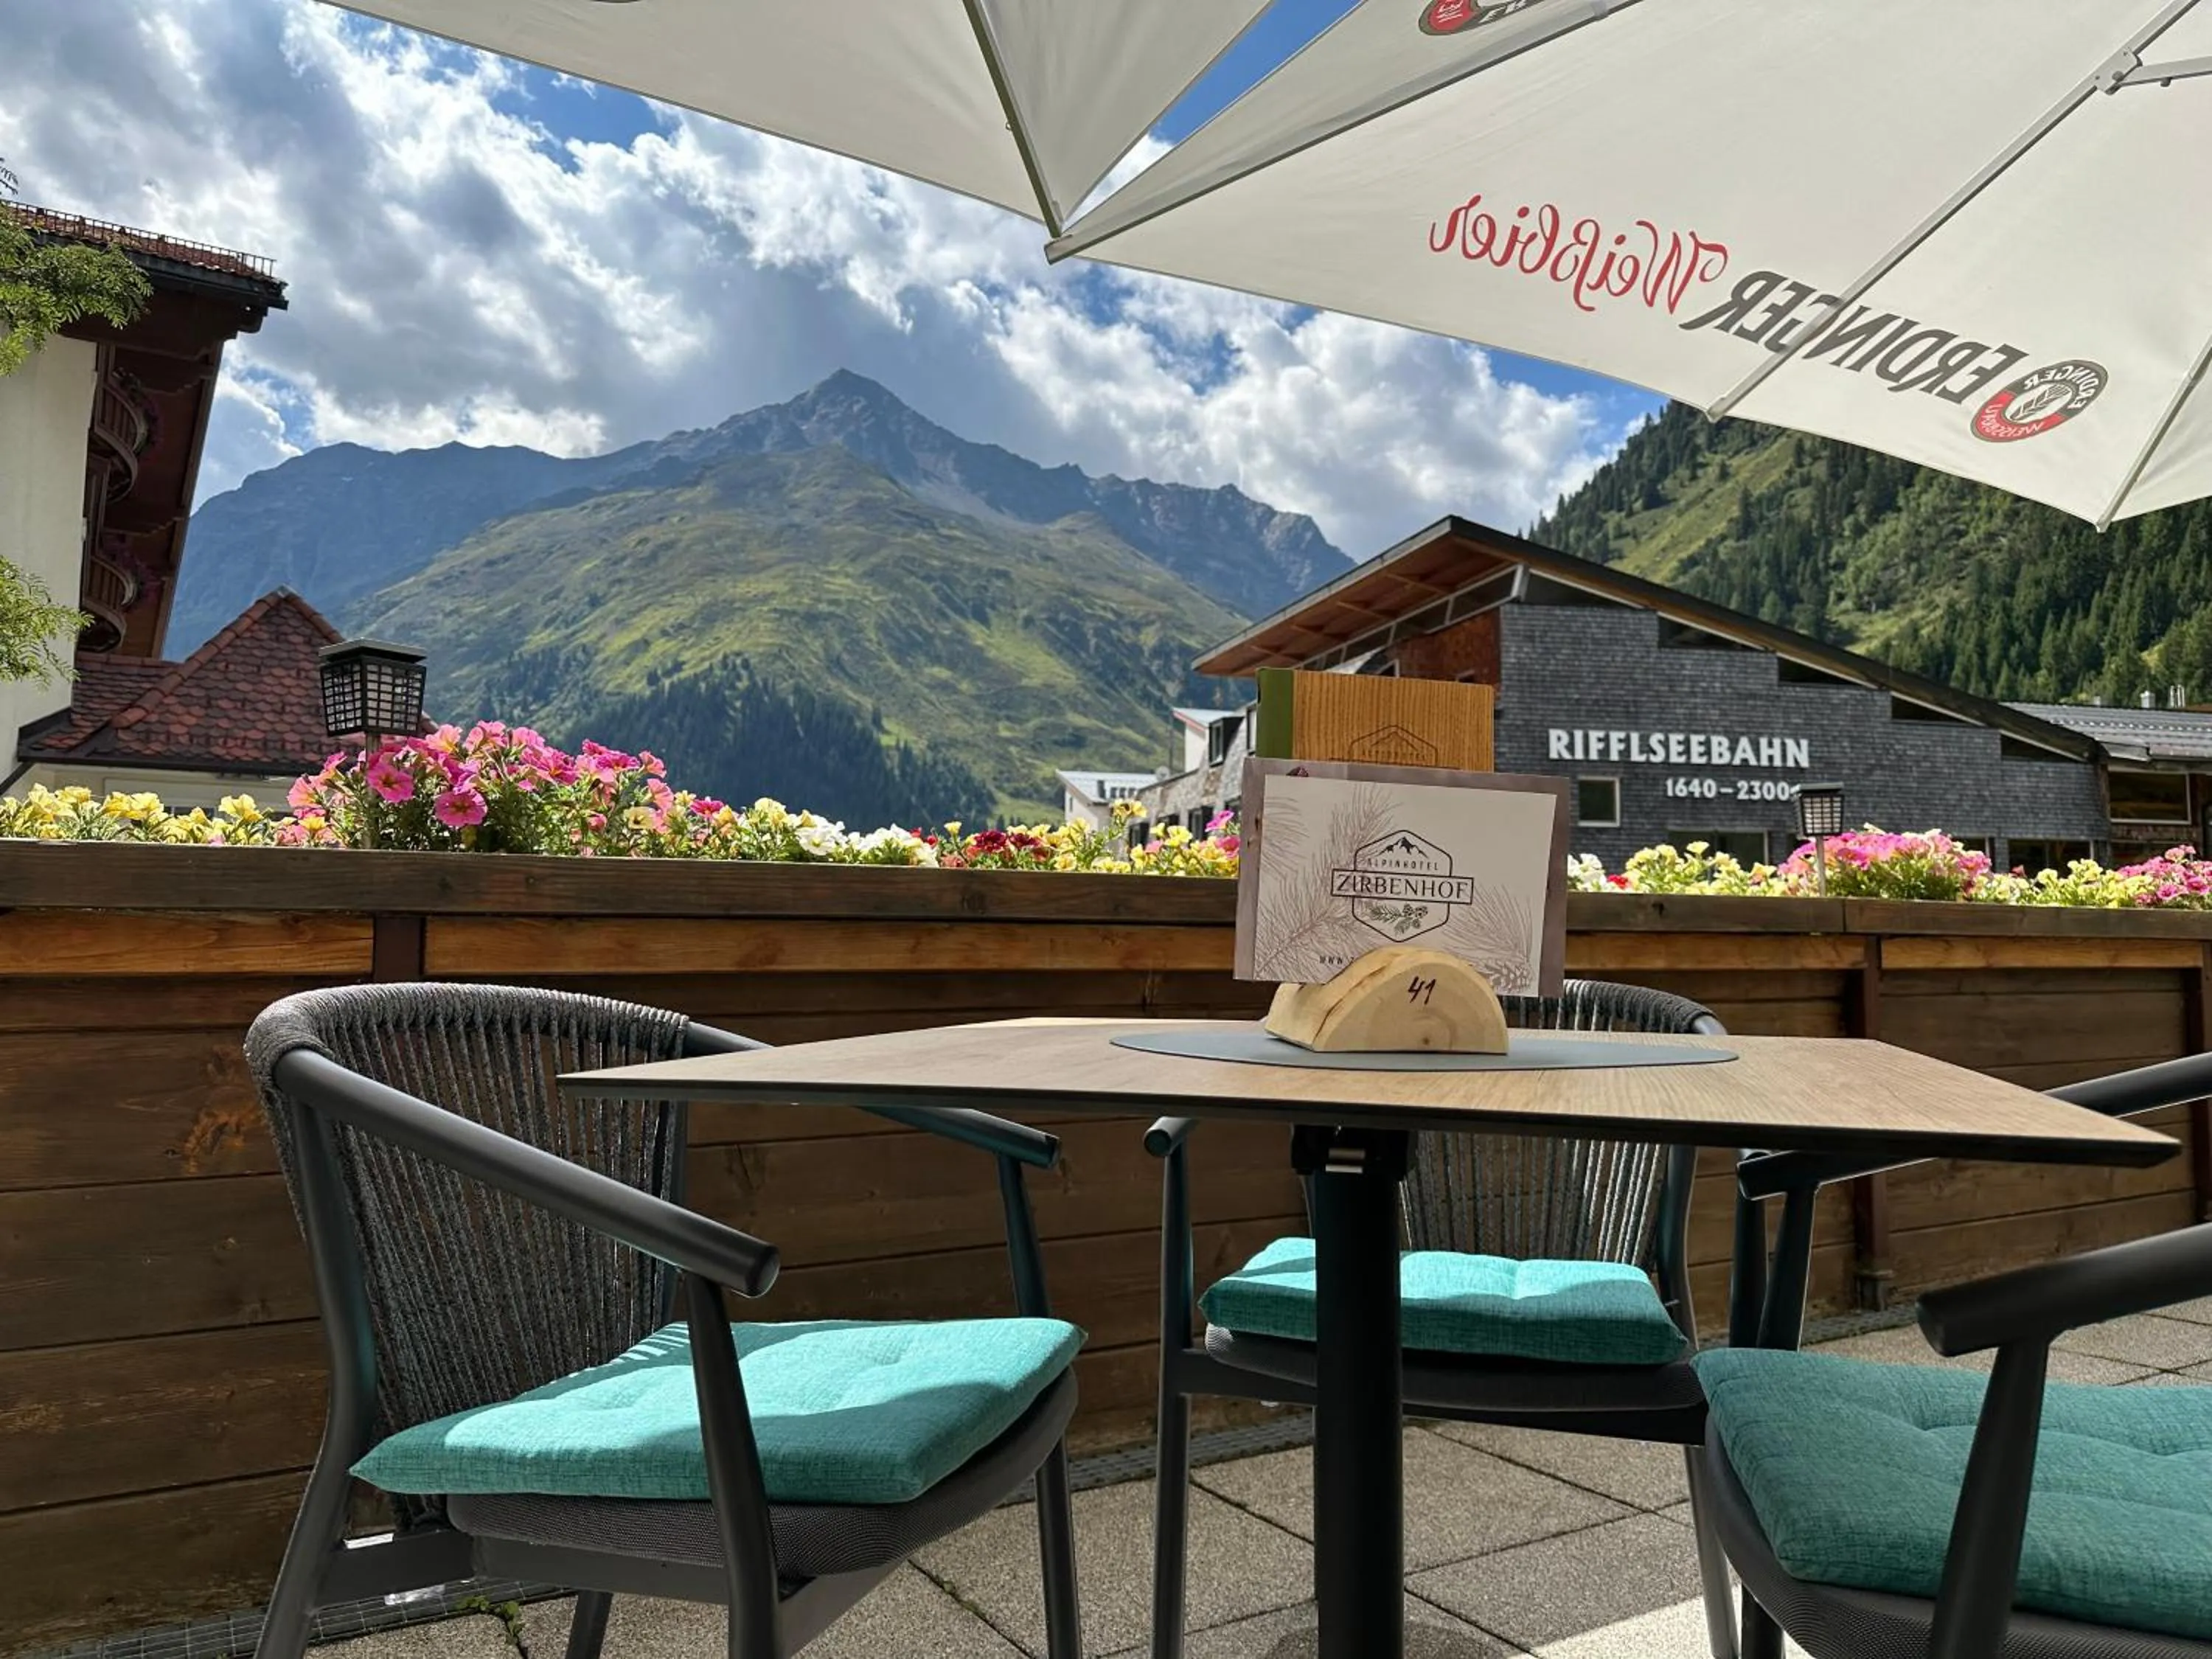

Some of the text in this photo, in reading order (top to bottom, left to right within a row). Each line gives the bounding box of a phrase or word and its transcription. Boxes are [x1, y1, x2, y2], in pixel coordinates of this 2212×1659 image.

[1548, 728, 1810, 769] RIFFLSEEBAHN
[1336, 873, 1469, 900] ZIRBENHOF
[1407, 975, 1436, 1006] 41
